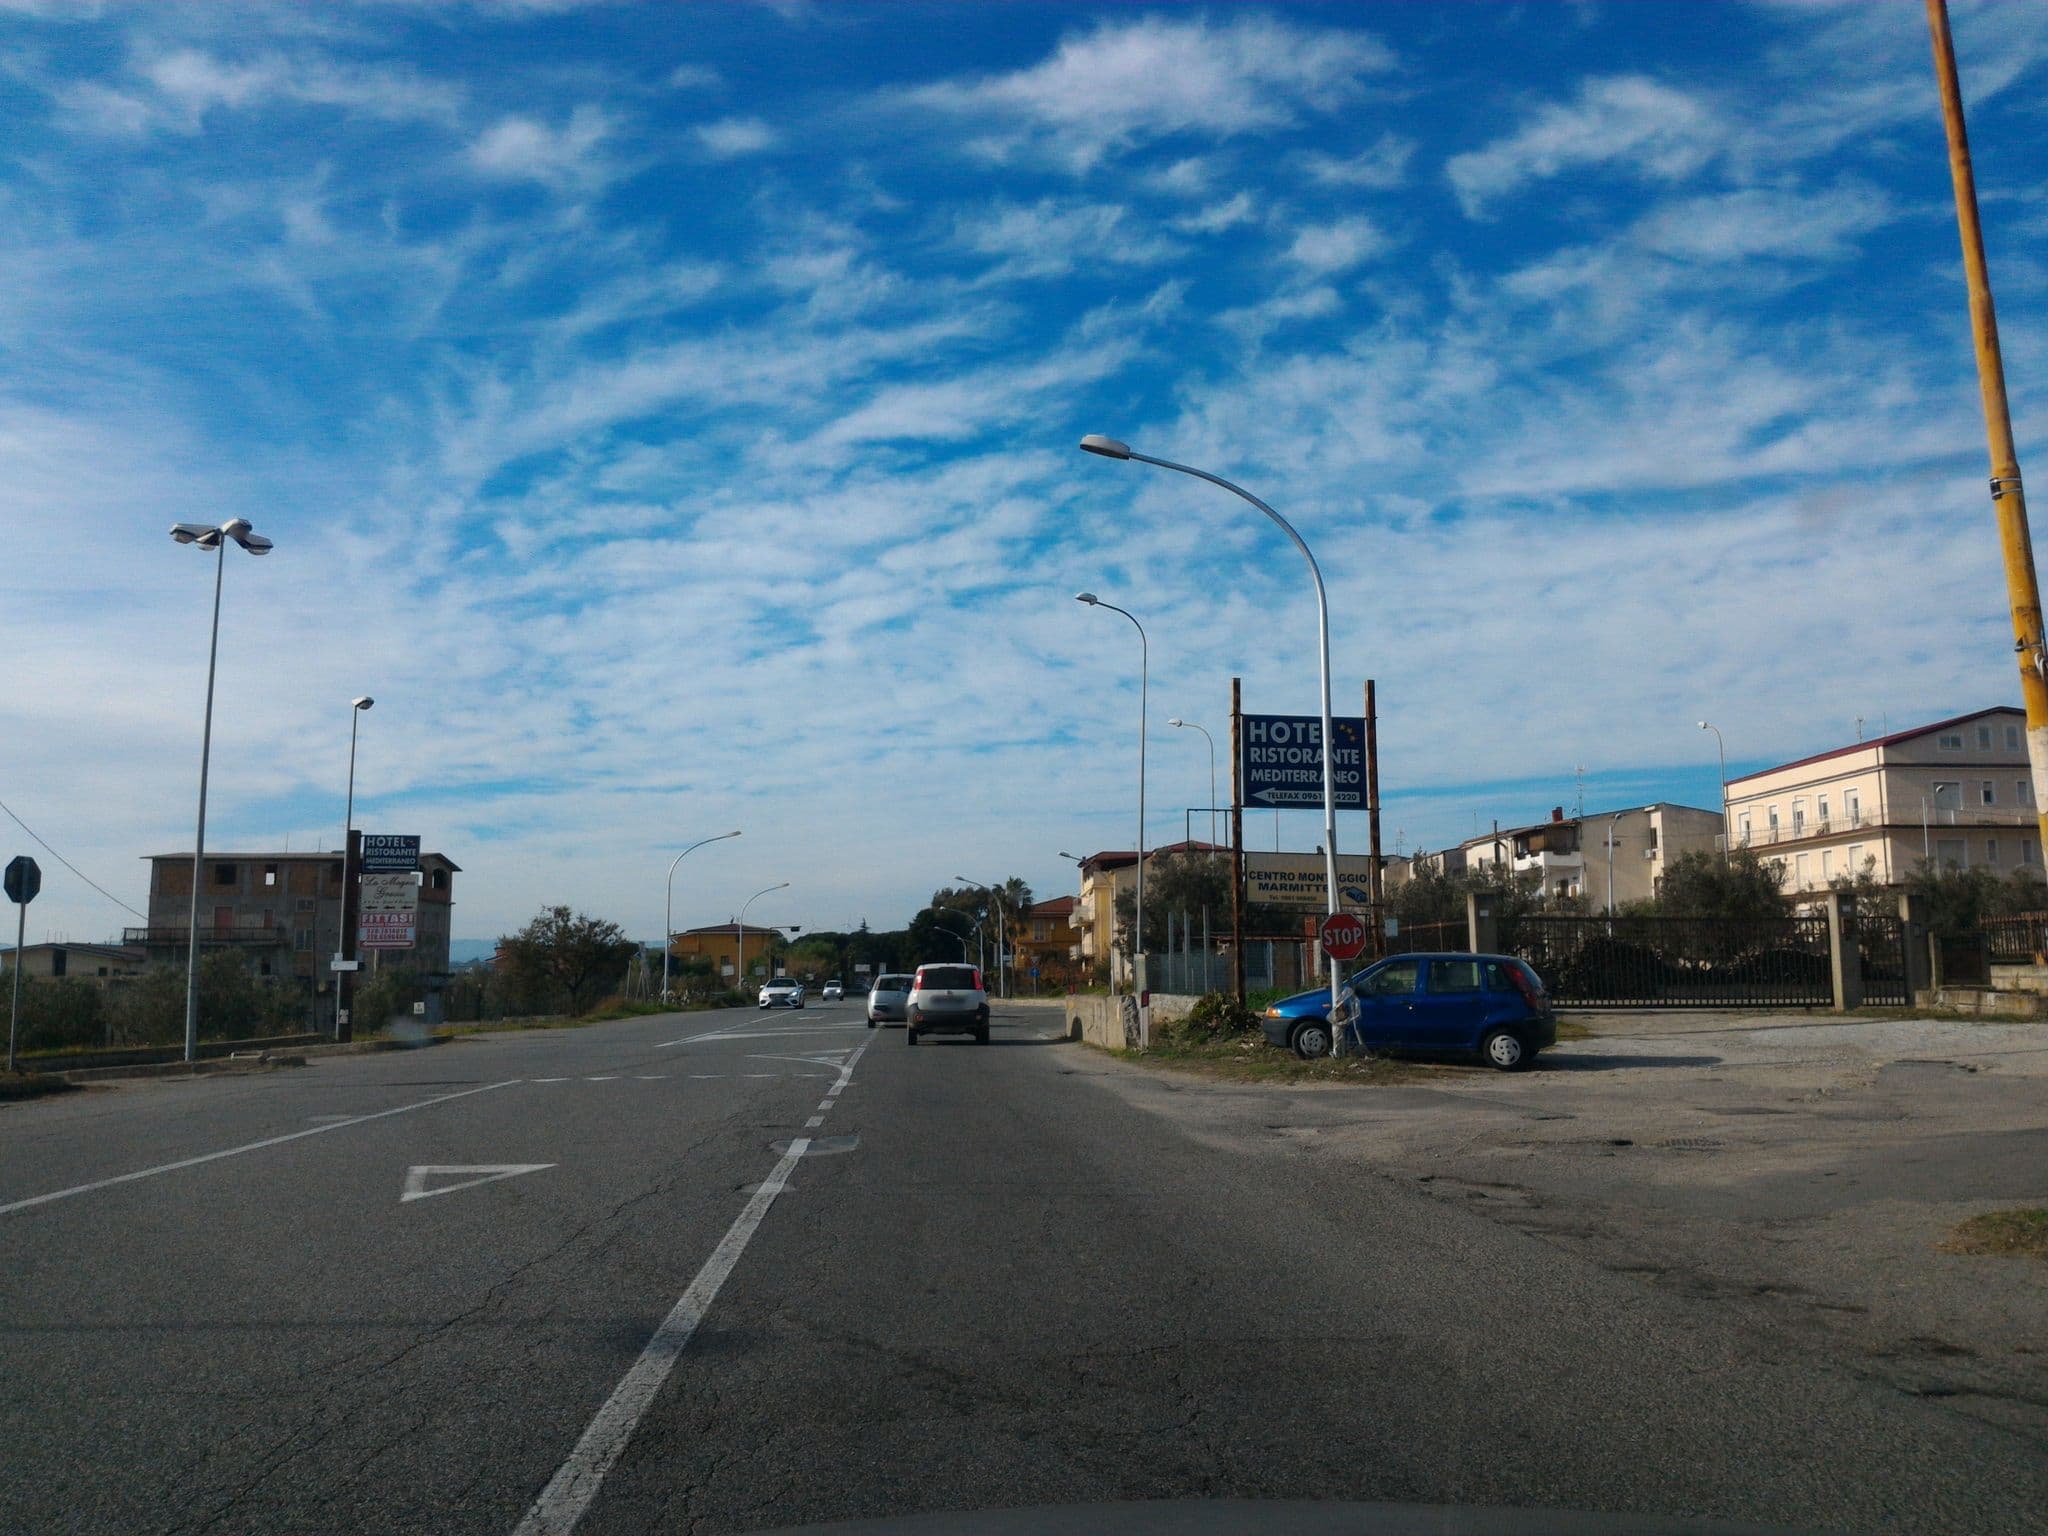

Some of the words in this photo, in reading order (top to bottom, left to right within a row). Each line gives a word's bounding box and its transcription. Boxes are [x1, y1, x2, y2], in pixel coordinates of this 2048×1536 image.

[1267, 792, 1299, 800] TELEFAX
[366, 836, 406, 847] HOTEL
[366, 847, 416, 857] RISTORANTE
[1249, 870, 1295, 881] CENTRO
[362, 914, 414, 923] FITTASI
[1323, 927, 1362, 946] STOP
